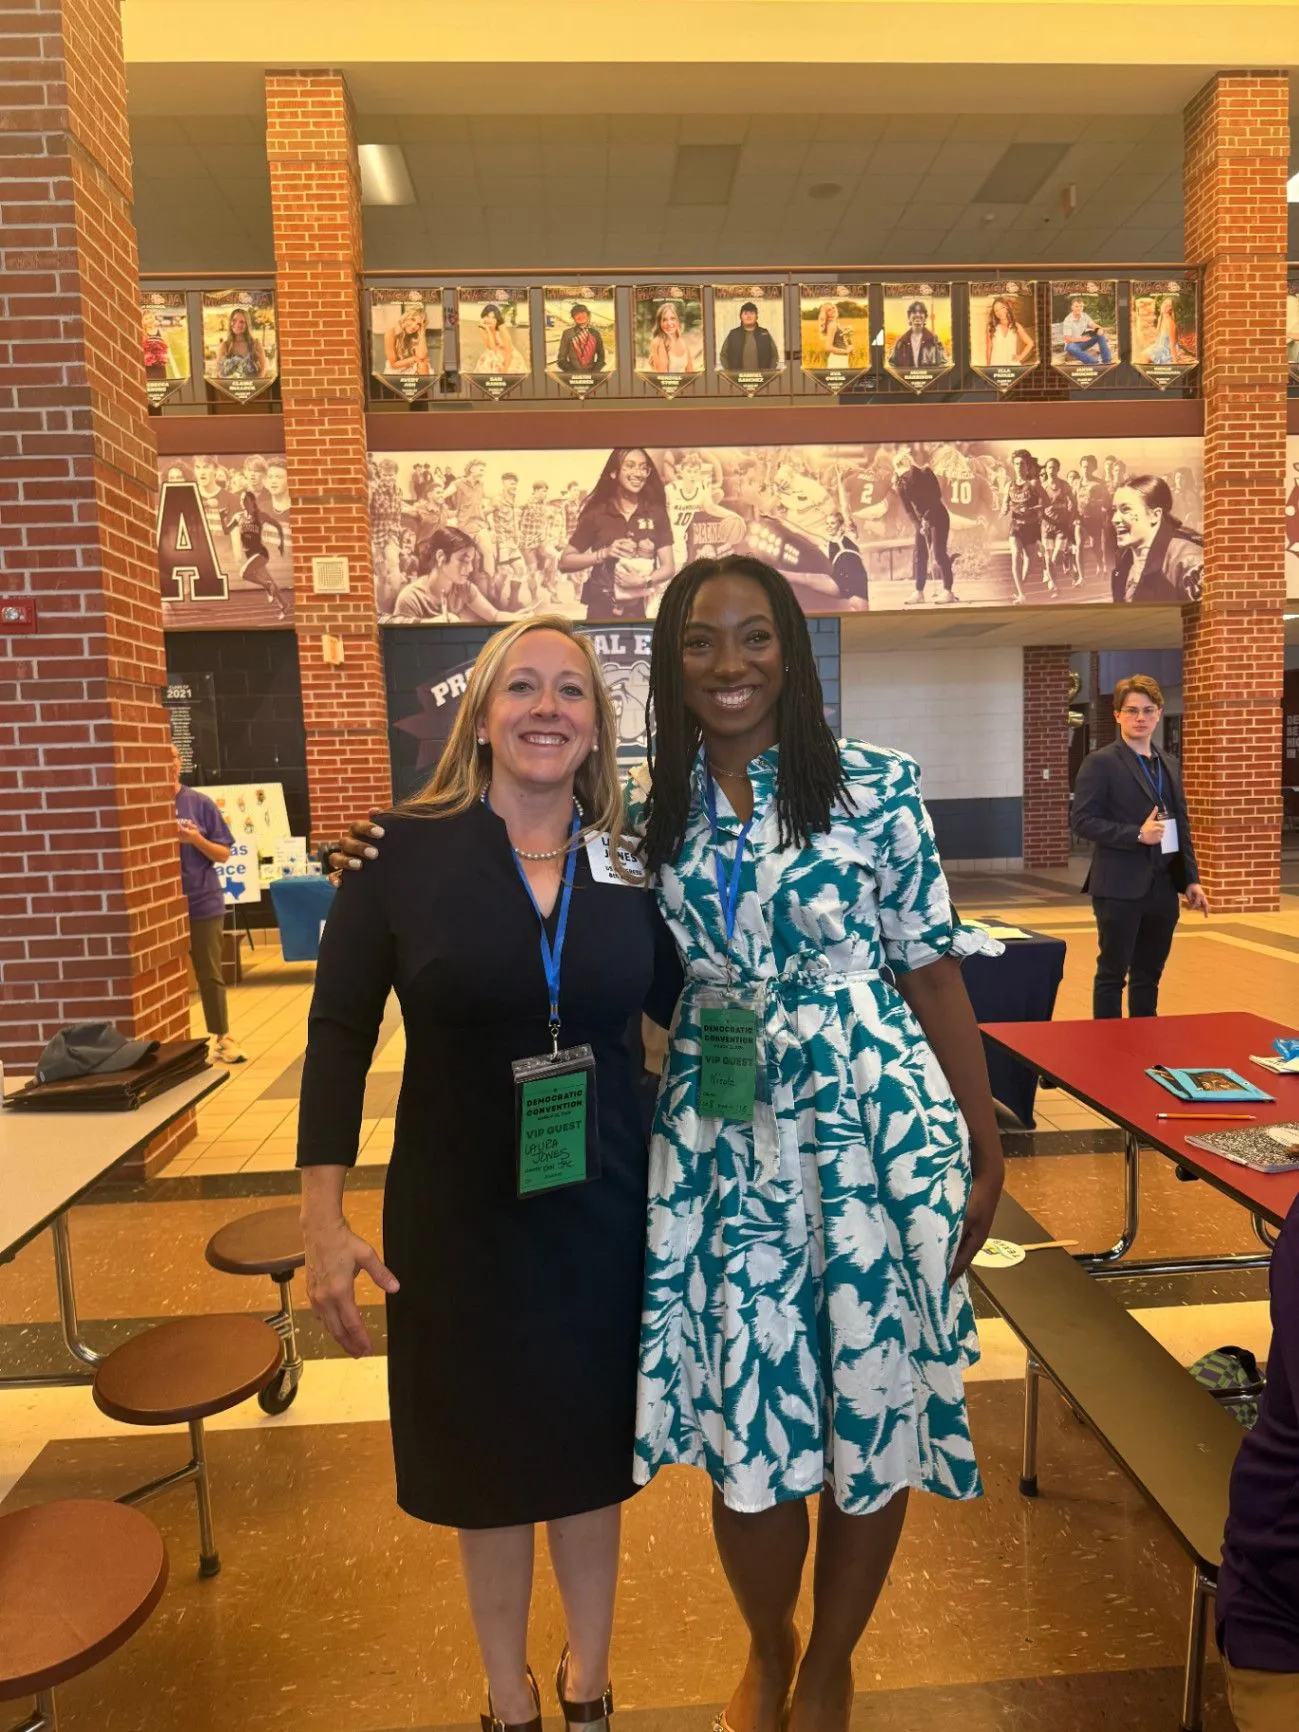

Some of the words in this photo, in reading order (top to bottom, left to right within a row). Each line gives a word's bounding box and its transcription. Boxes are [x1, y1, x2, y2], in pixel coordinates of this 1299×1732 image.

[861, 482, 874, 504] 2
[951, 480, 972, 504] 10
[674, 512, 692, 526] 10
[167, 689, 192, 699] 2021
[704, 1025, 753, 1034] DEMOCRATIC
[705, 1055, 721, 1064] VIP
[722, 1056, 753, 1067] GUEST
[526, 1089, 583, 1107] DEMOCRATIC
[526, 1100, 583, 1117] CONVENTION
[526, 1129, 545, 1140] VIP
[546, 1120, 583, 1136] GUEST
[525, 1138, 559, 1155] LAURA
[531, 1147, 570, 1164] JONES
